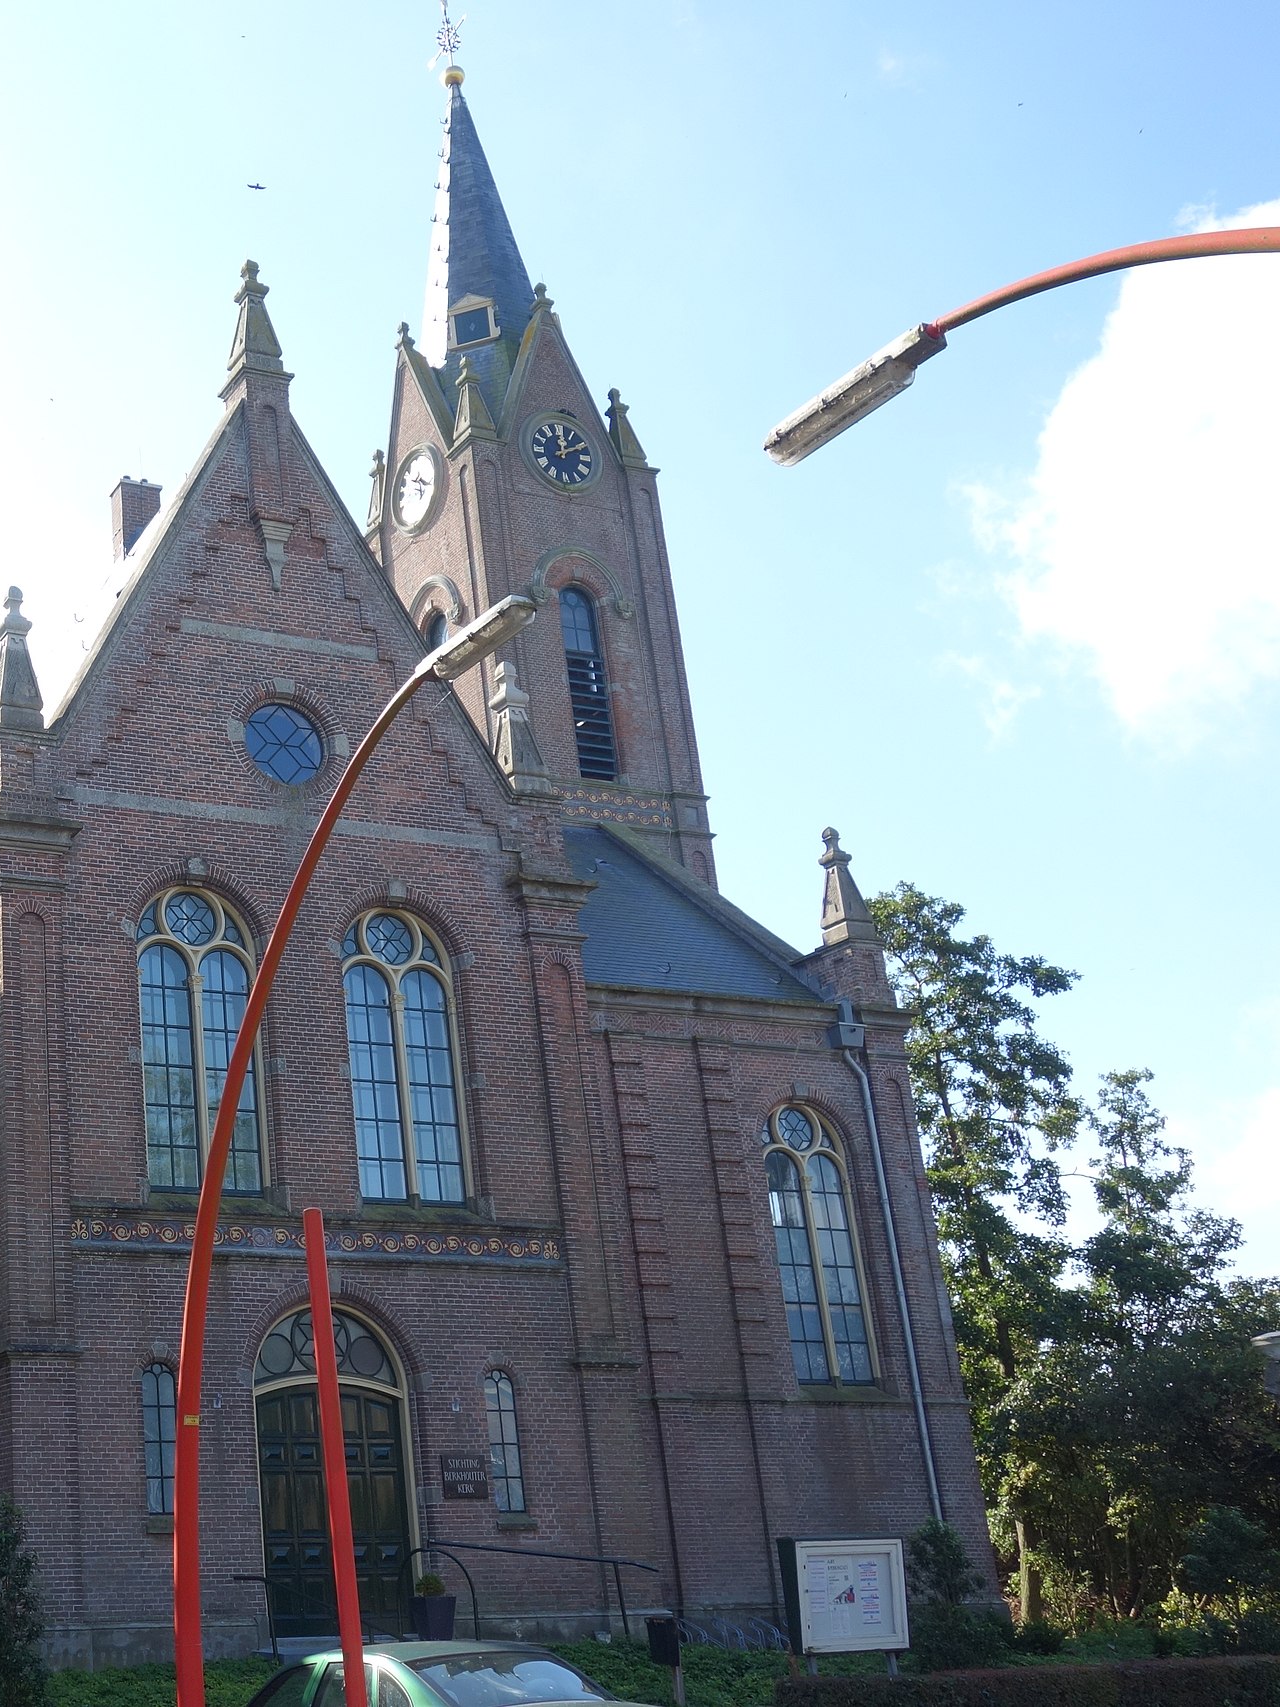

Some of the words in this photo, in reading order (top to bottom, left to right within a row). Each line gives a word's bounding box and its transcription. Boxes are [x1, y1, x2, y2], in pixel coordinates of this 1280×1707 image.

[542, 425, 553, 437] XI
[568, 431, 575, 440] I
[535, 432, 546, 444] X
[573, 472, 581, 482] V
[448, 1459, 480, 1468] STICHTING
[444, 1471, 486, 1481] BERKHOUTER
[457, 1484, 475, 1493] KERK
